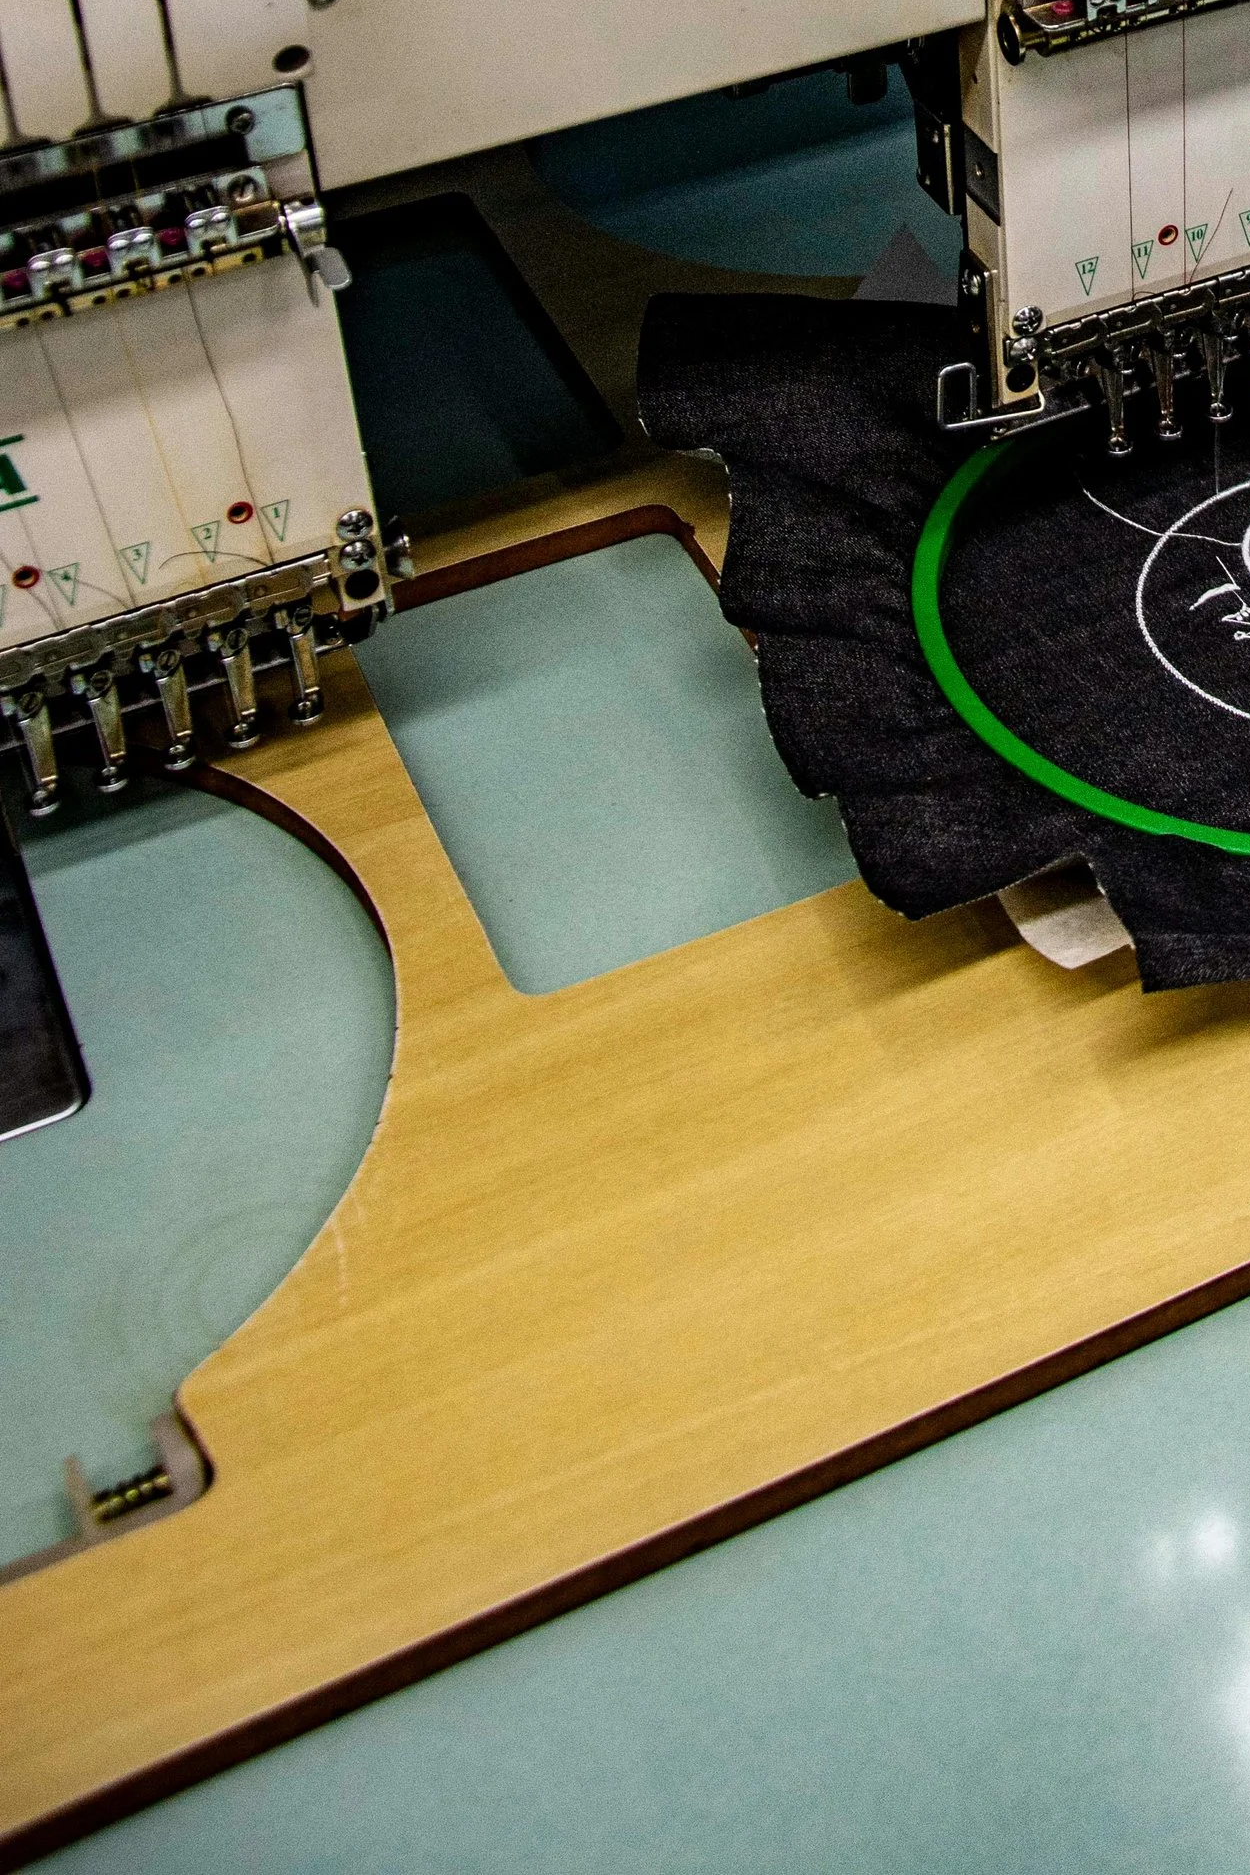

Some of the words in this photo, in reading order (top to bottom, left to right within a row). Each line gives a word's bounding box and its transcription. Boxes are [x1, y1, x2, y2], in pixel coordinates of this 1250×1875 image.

[1190, 229, 1204, 241] 10
[1136, 247, 1149, 258] 11
[1081, 261, 1095, 275] 12
